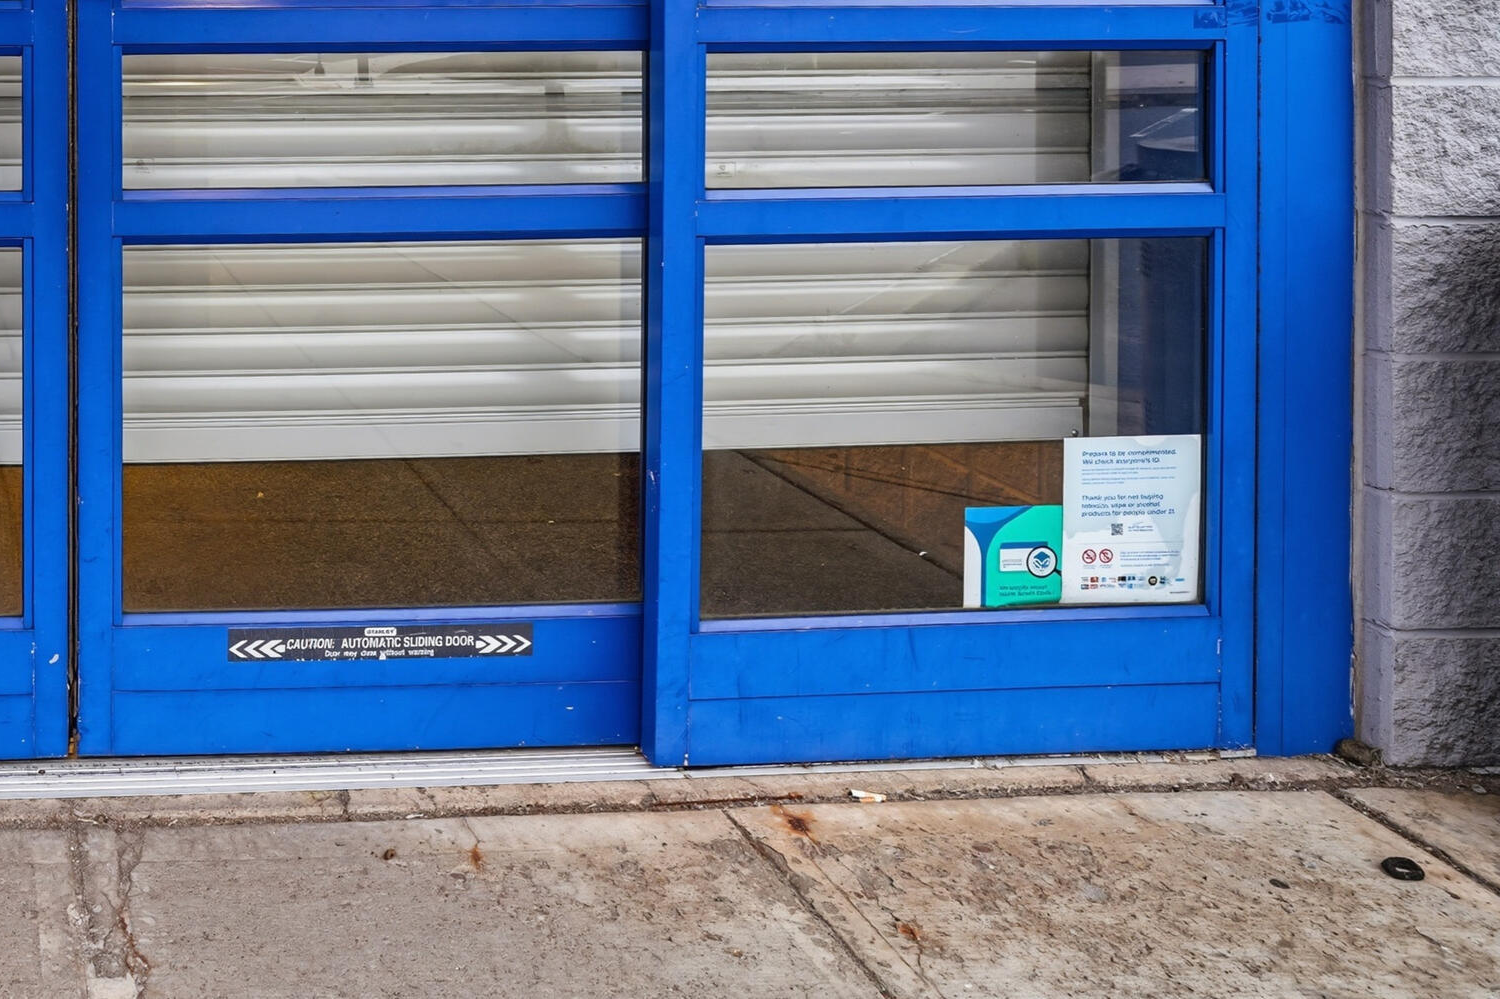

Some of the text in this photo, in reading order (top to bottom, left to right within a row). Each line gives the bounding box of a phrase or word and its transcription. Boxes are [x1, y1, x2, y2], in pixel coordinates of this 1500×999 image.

[287, 635, 475, 650] CAUTION: AUTOMATIC SLIDING DOOR
